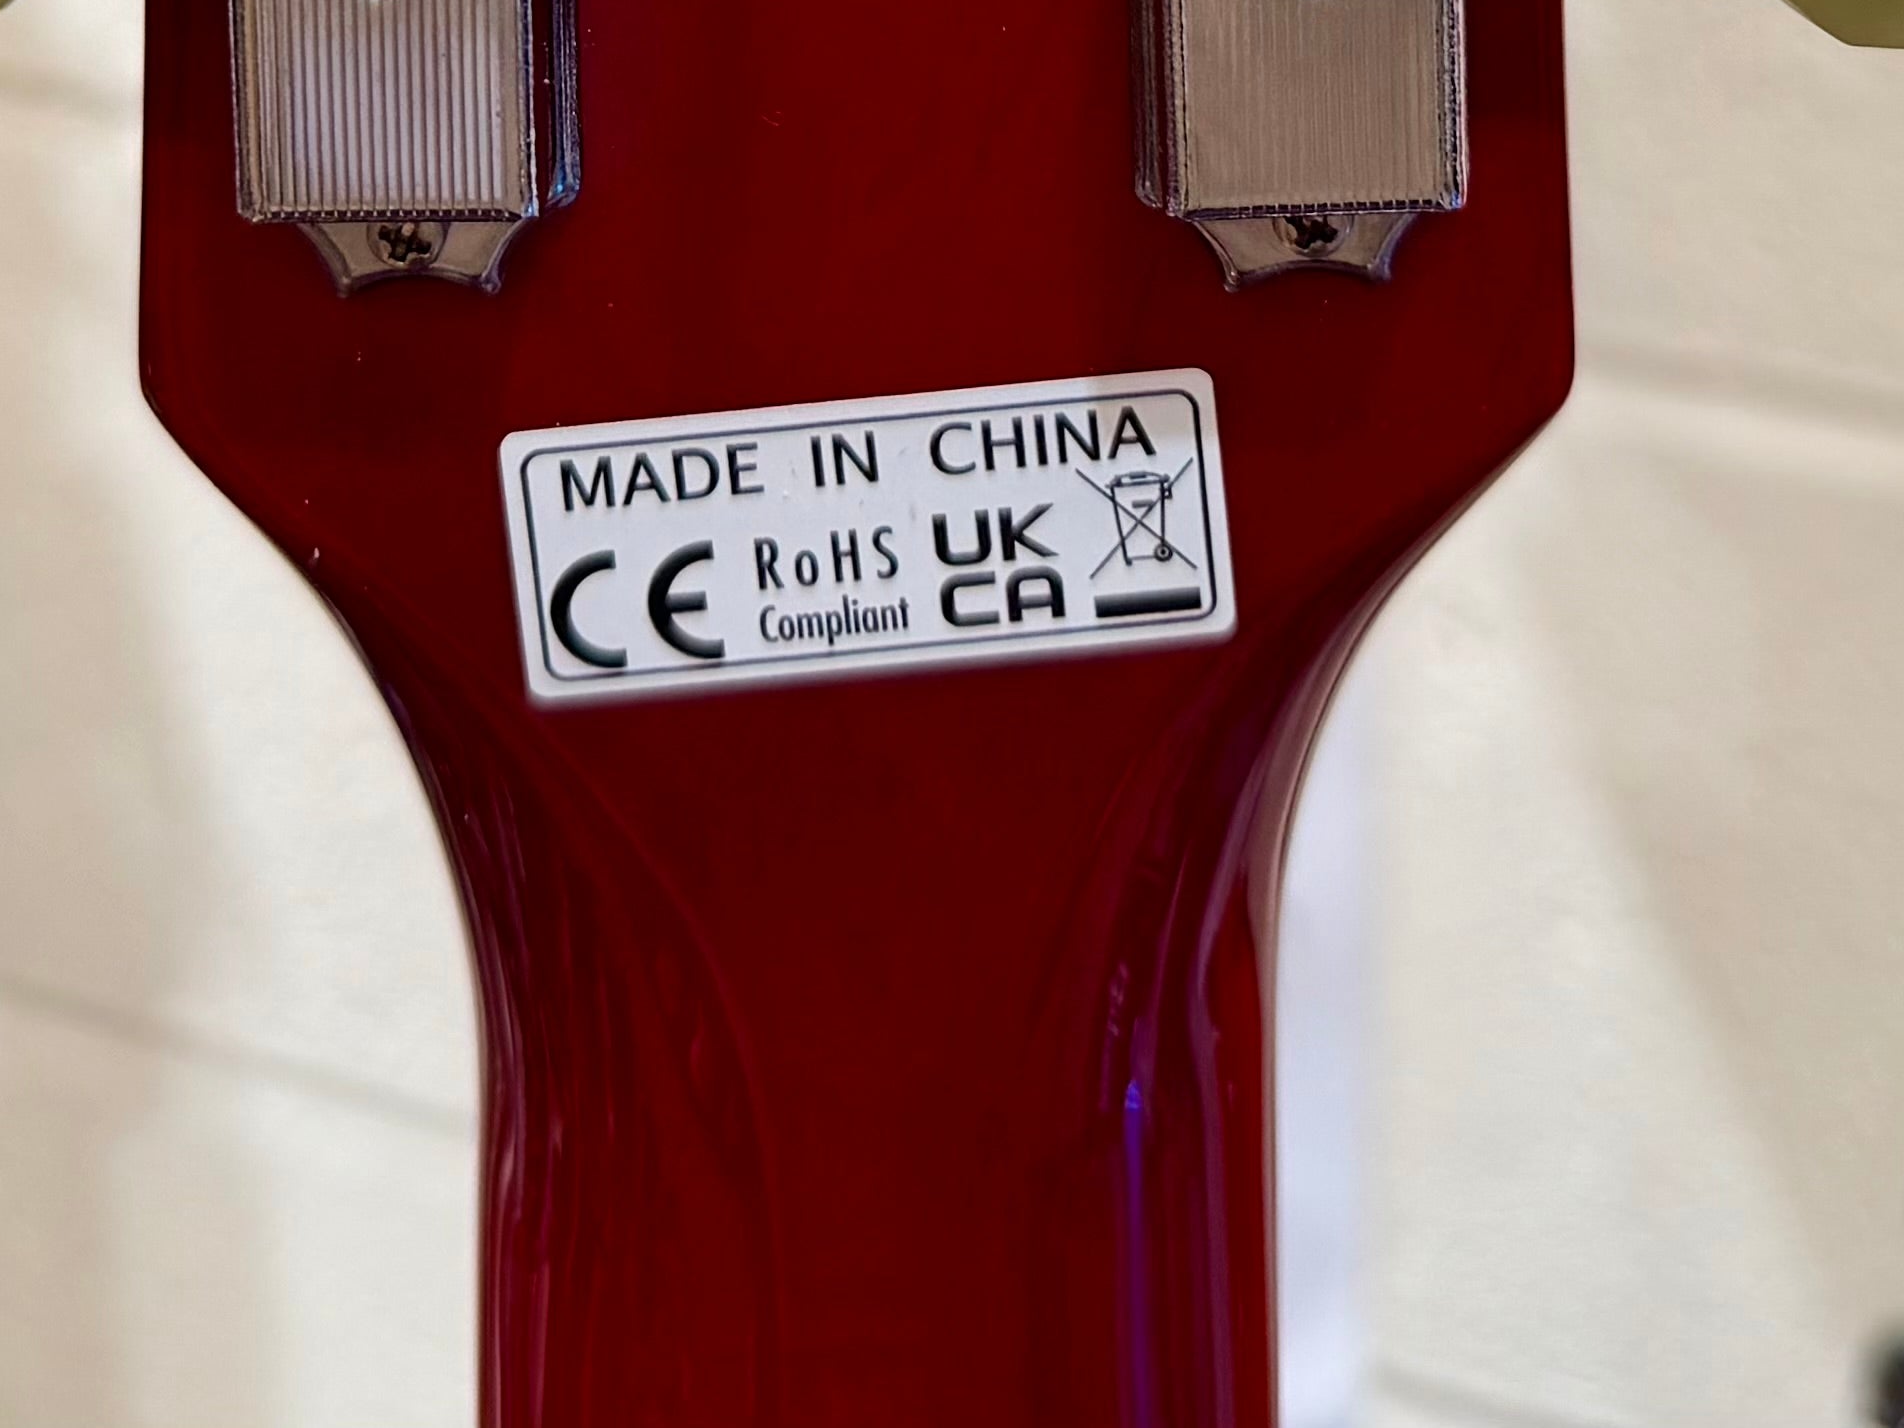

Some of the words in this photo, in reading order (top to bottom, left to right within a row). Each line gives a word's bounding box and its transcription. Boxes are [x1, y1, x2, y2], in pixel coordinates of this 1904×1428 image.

[560, 442, 765, 512] MADE
[811, 430, 879, 487] IN
[929, 406, 1157, 475] CHINA
[755, 527, 900, 590] RoHS
[931, 503, 1058, 566] UK
[550, 540, 725, 668] CE
[759, 595, 909, 647] Compliant
[939, 567, 1065, 627] CA
